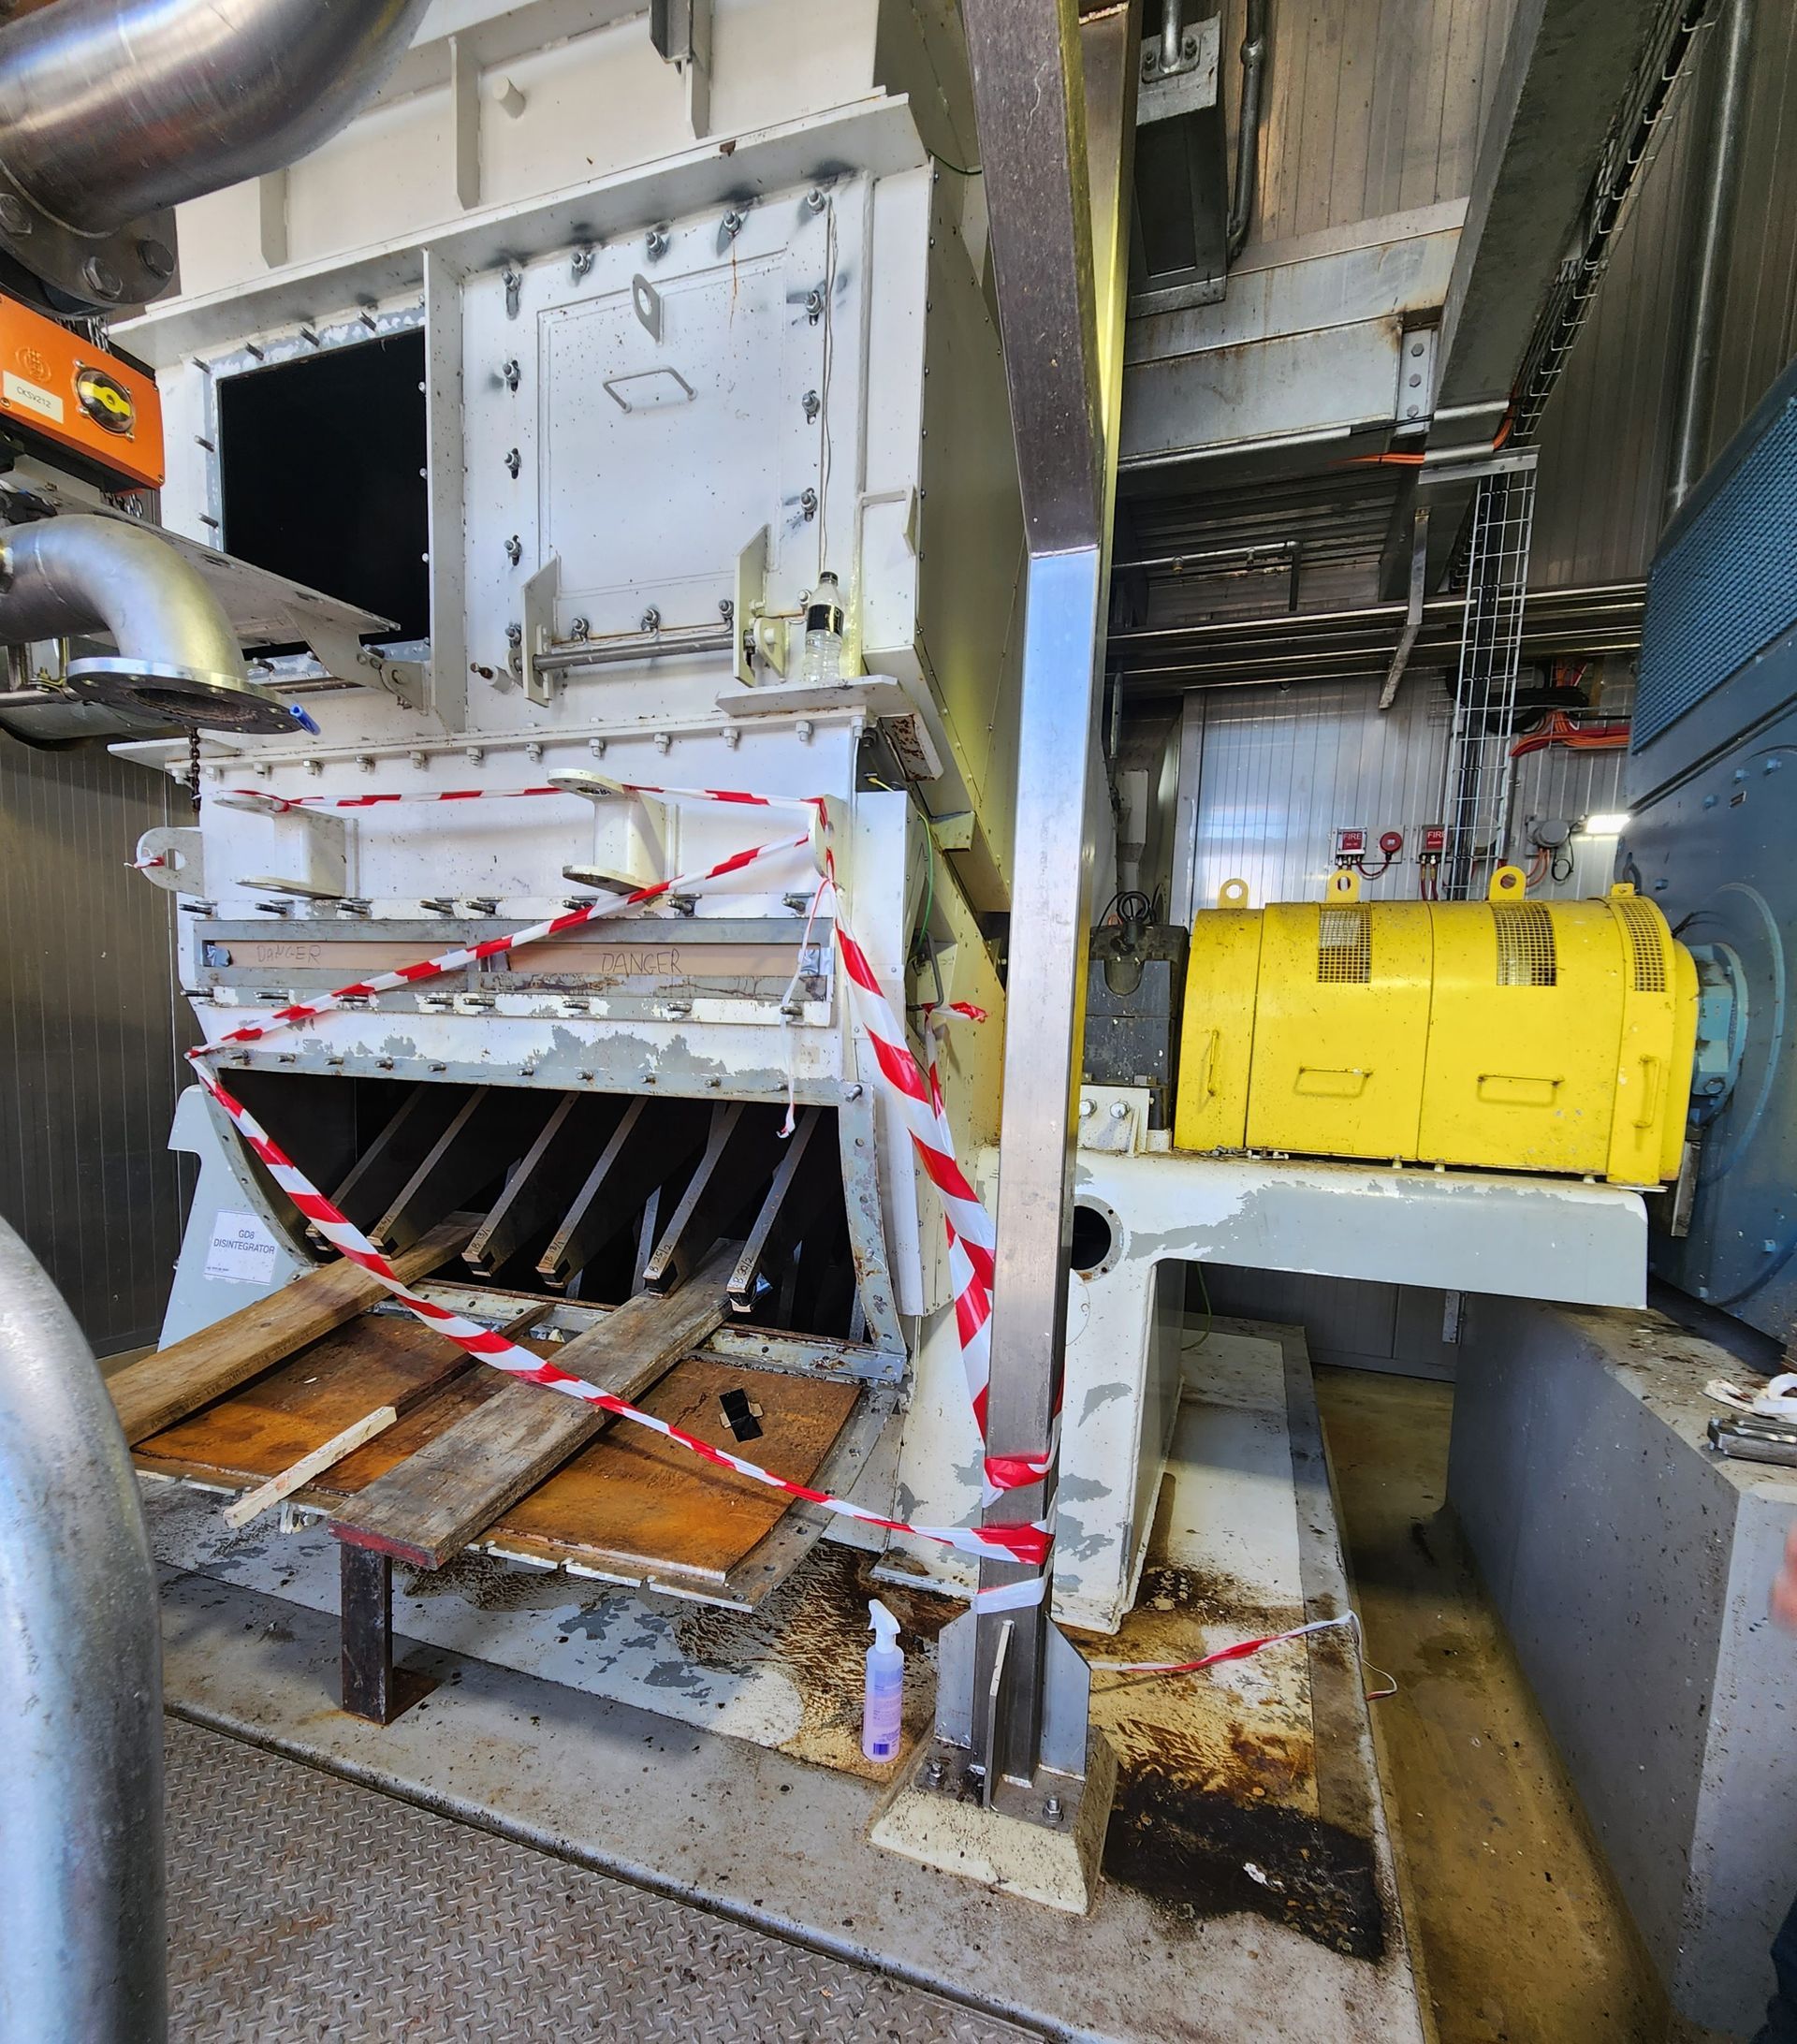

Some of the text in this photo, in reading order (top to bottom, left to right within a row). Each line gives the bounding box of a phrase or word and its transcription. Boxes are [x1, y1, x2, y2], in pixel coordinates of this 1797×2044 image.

[1343, 832, 1362, 840] FIRE
[256, 944, 322, 965] DANGER
[601, 948, 682, 976] DANGER
[213, 1238, 275, 1255] DISINTEGRATOR
[653, 1244, 673, 1263] 25/2
[737, 1257, 754, 1275] 30/2
